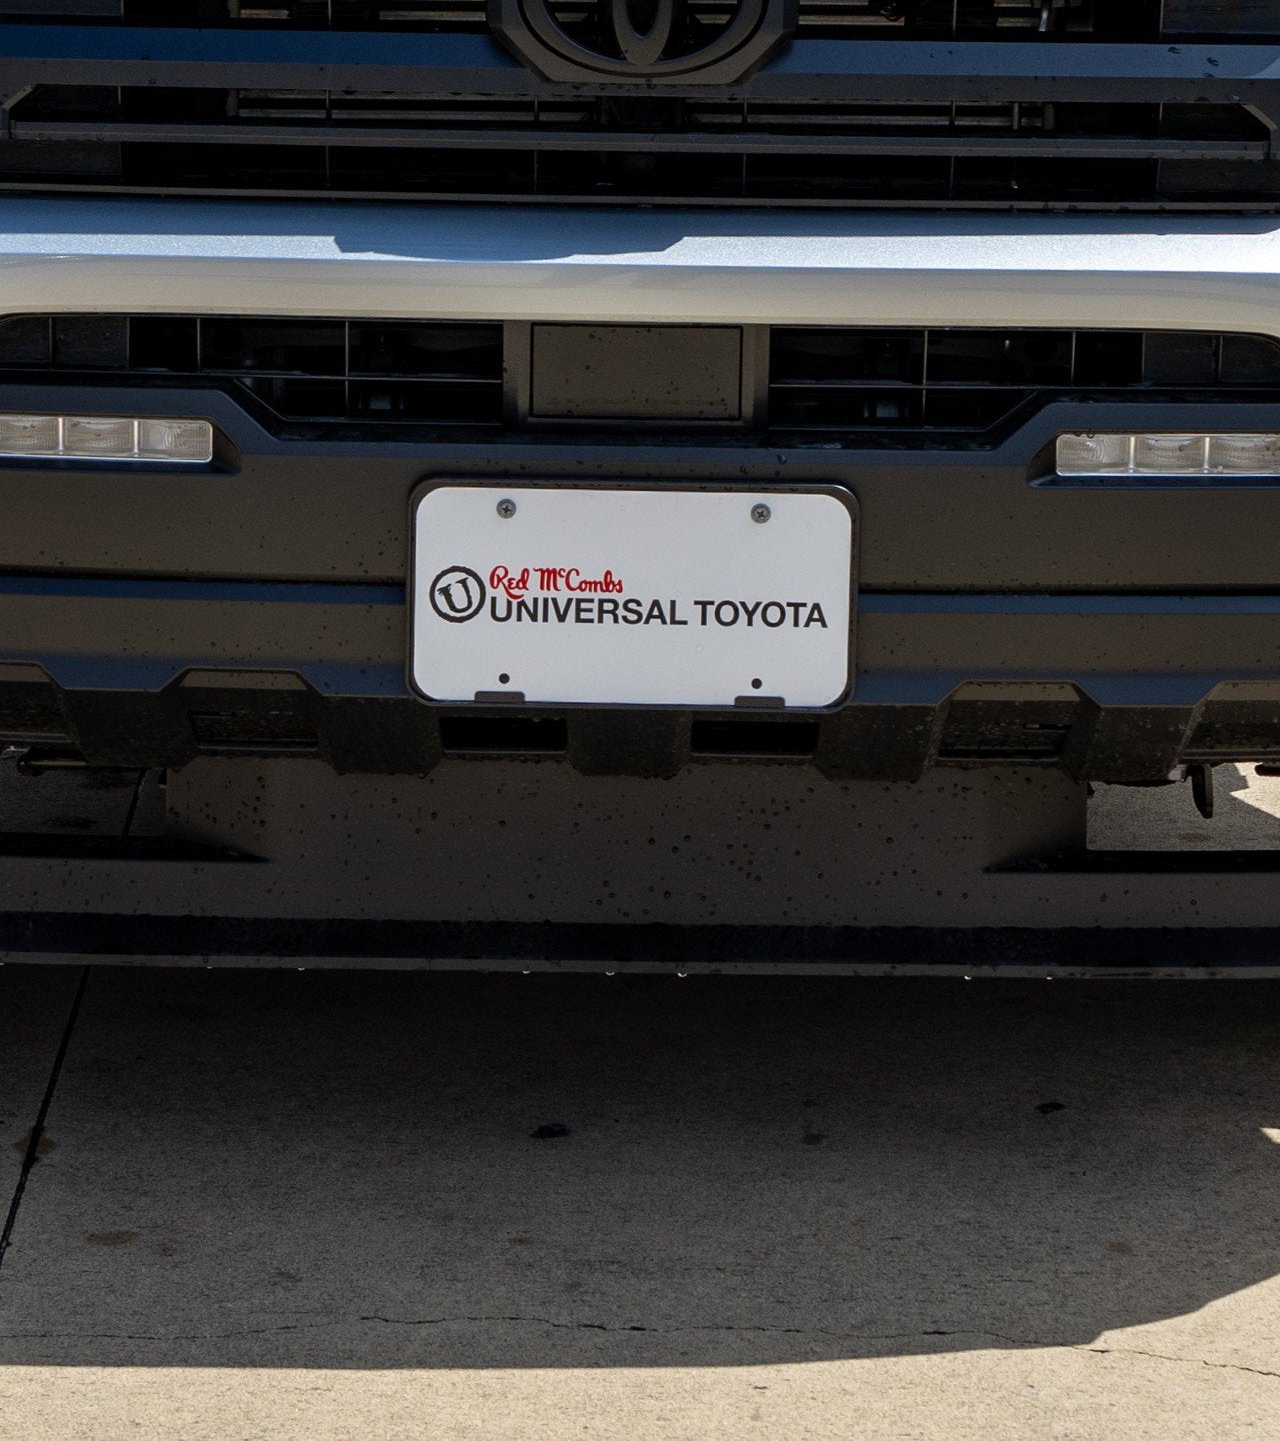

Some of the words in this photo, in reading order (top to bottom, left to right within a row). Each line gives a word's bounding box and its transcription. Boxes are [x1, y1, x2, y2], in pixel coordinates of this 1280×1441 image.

[489, 565, 529, 600] Red
[534, 566, 624, 594] McCombs
[490, 597, 688, 626] UNIVERSAL
[693, 599, 828, 629] TOYOTA
